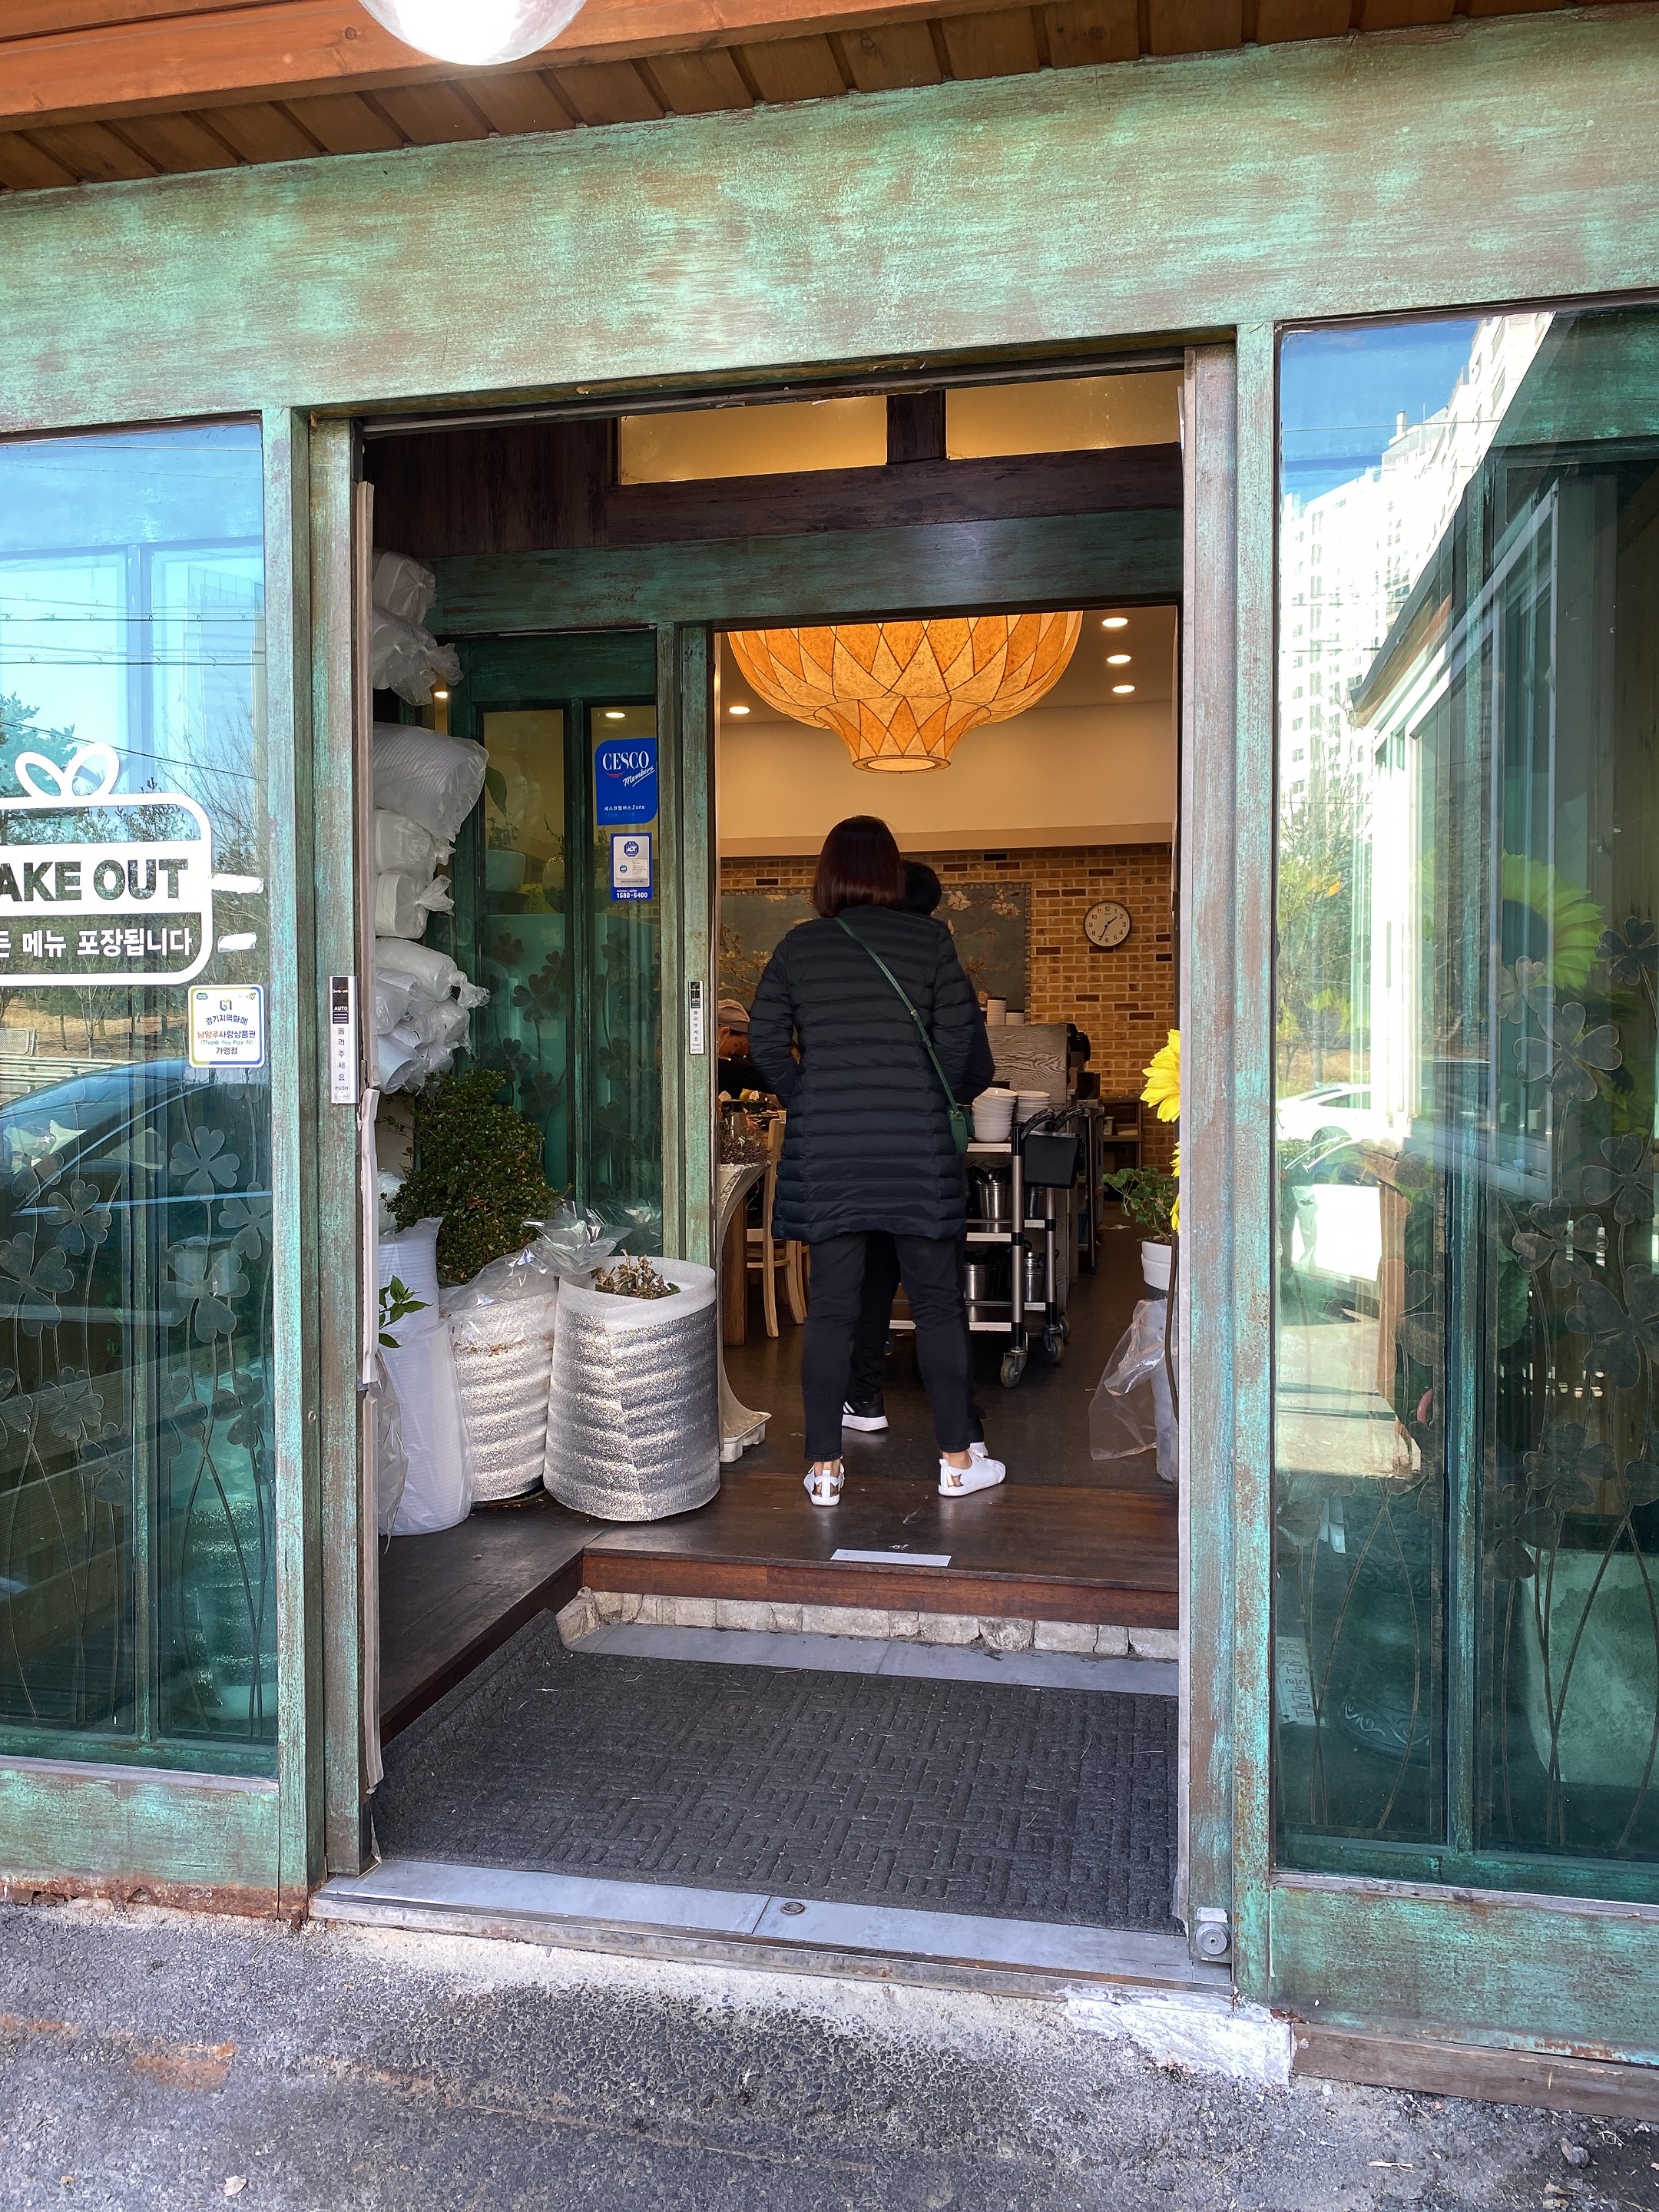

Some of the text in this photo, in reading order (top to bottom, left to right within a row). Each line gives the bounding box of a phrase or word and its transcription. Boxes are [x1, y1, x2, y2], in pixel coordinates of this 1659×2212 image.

[602, 751, 650, 770] CESCO
[622, 765, 654, 786] Members
[0, 858, 189, 902] AKE OUT
[22, 930, 67, 958] 메뉴
[77, 927, 193, 958] 포장됩니다
[206, 1015, 249, 1025] 경기지역화폐
[216, 1047, 238, 1055] 가맹점
[1279, 1641, 1301, 1656] 신발
[1286, 1677, 1314, 1718] 들어오세요
